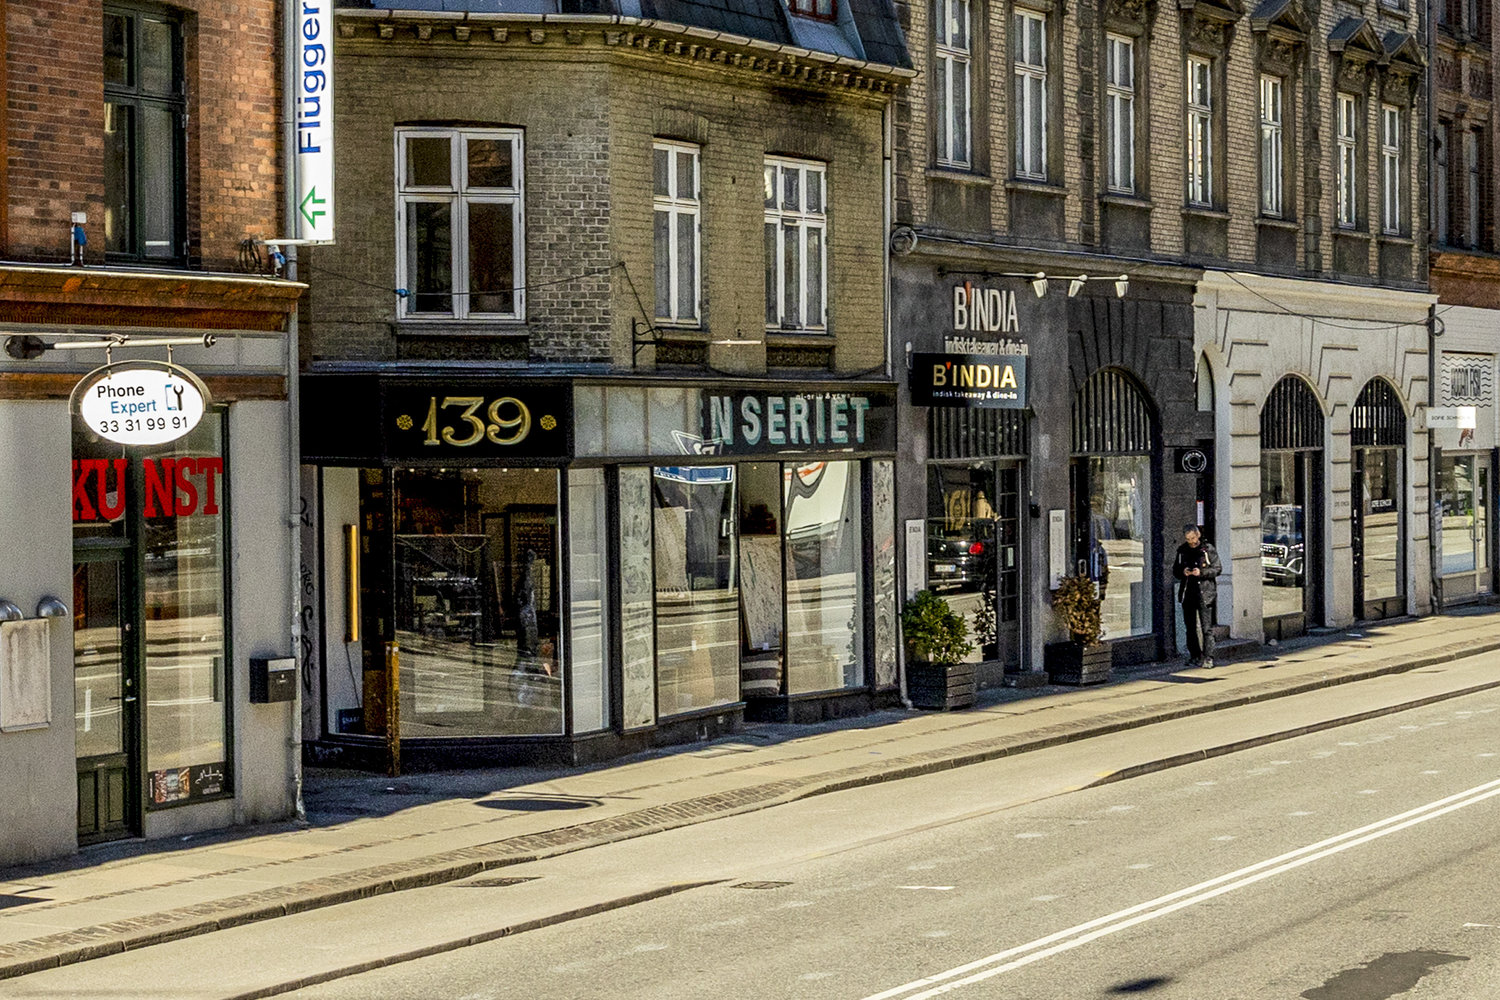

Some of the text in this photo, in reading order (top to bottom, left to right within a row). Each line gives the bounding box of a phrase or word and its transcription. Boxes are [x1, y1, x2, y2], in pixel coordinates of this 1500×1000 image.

[298, 2, 326, 154] Flügger
[97, 385, 145, 398] Phone
[110, 400, 158, 416] Expert
[100, 416, 188, 434] 33 31 99 91
[421, 396, 532, 447] 139
